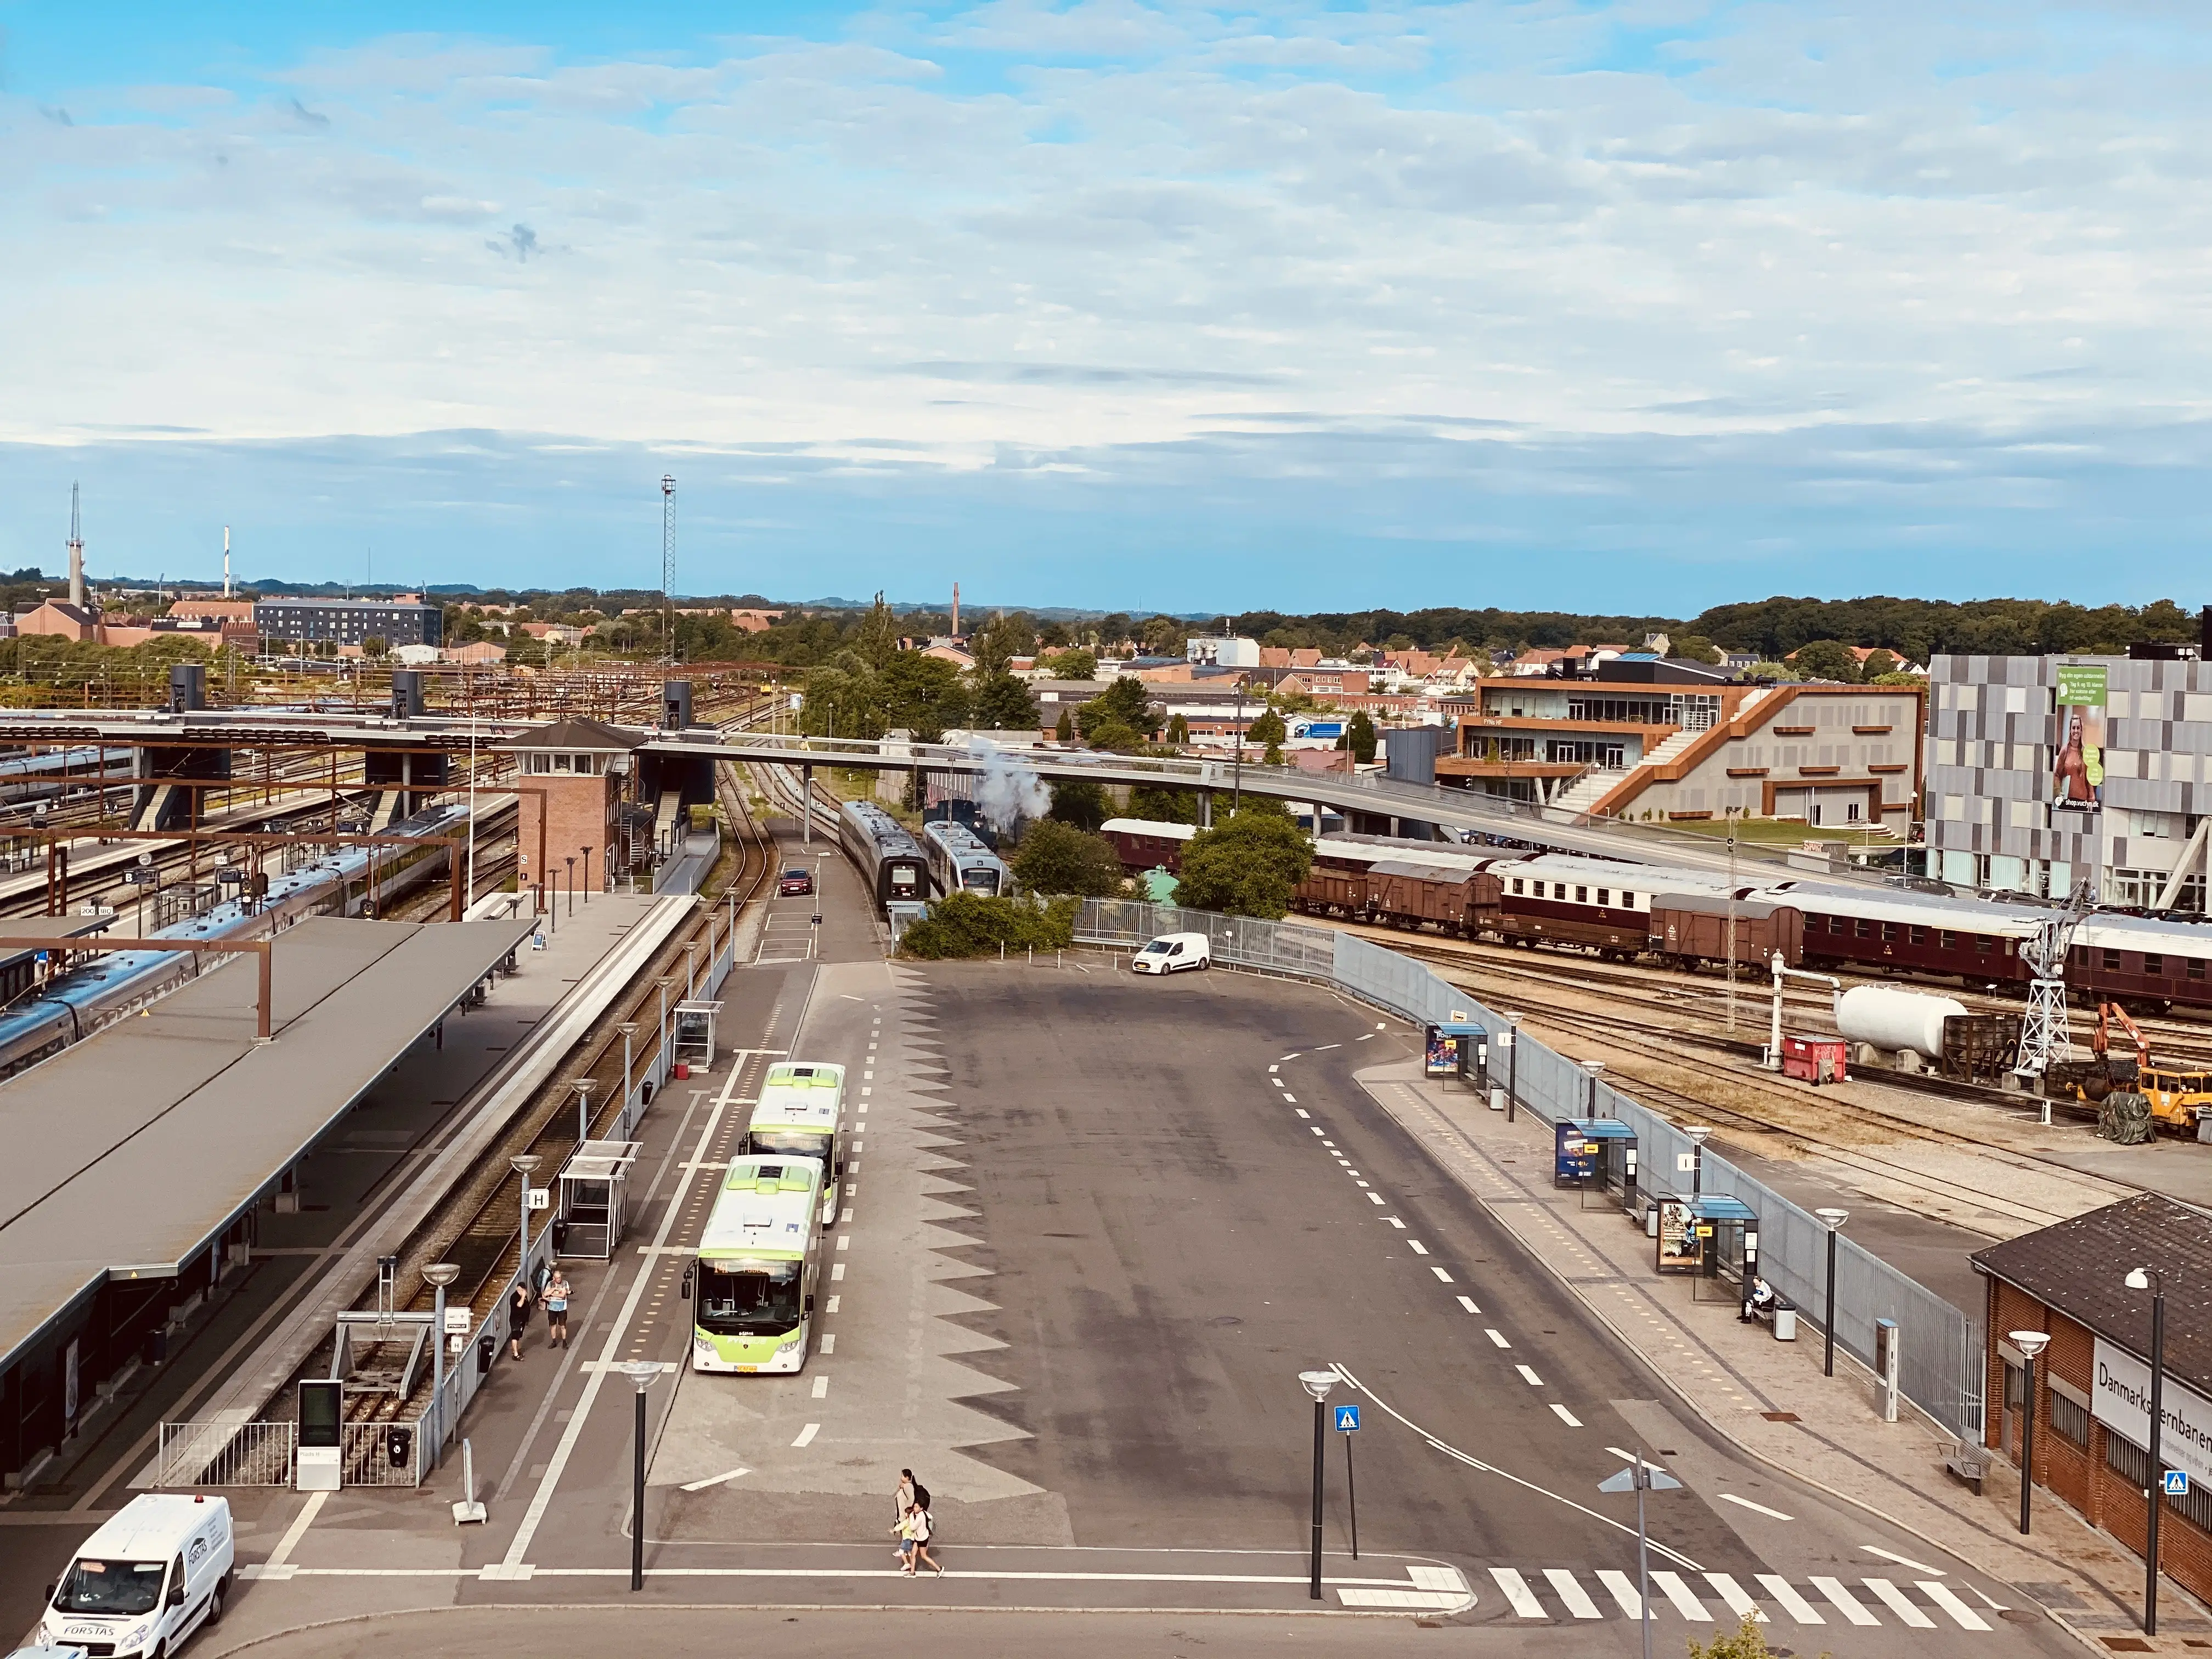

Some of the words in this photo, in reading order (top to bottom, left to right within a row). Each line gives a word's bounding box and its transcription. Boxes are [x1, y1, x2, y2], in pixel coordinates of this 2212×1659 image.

[263, 824, 270, 832] A
[125, 873, 133, 882] B
[534, 1194, 543, 1205] H
[714, 1262, 729, 1273] 141
[2099, 1362, 2151, 1415] Danmarks
[64, 1627, 116, 1636] FORSTAS
